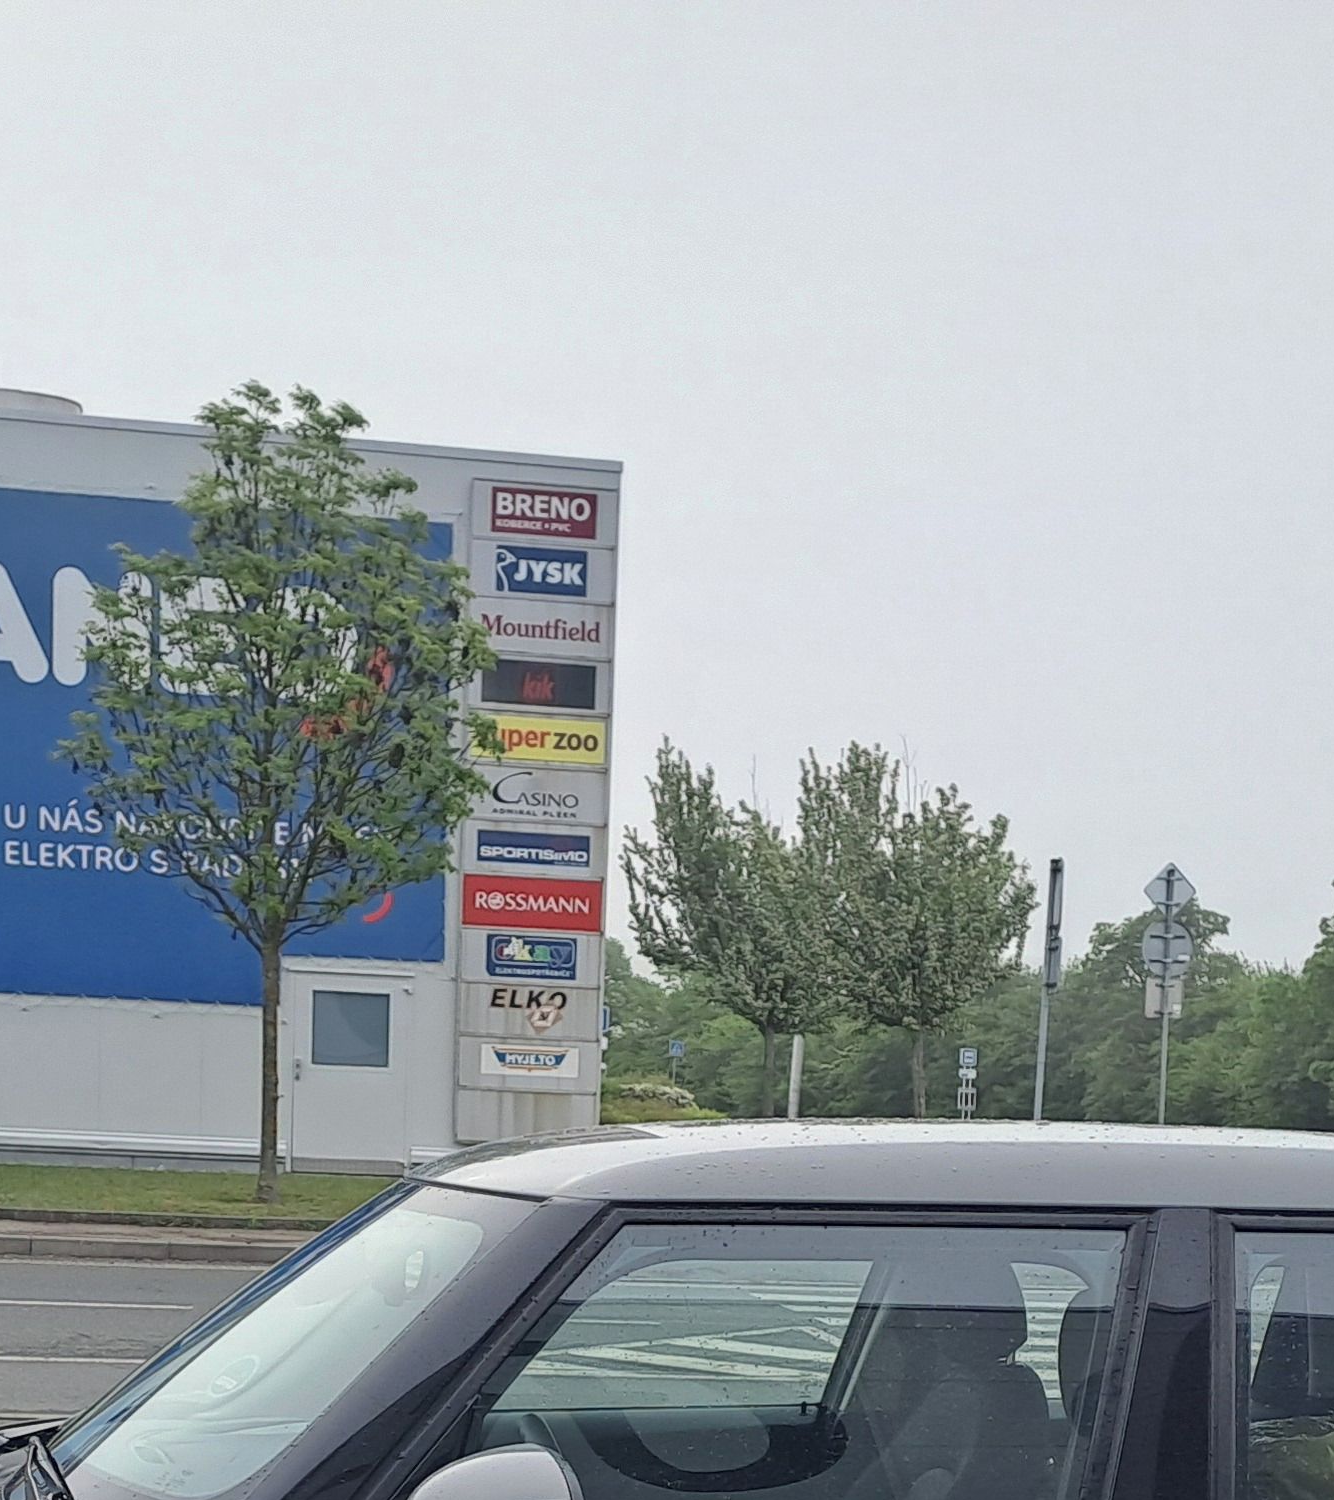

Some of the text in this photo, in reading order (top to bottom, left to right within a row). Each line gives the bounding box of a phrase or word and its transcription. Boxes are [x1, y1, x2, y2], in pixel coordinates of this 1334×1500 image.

[495, 491, 591, 522] BRENO
[513, 559, 584, 586] JYSK
[481, 613, 601, 643] Mountfield
[492, 771, 579, 808] CASINO
[3, 804, 25, 829] U
[39, 800, 103, 834] NÁS
[3, 841, 139, 873] ELEKTRO
[150, 848, 169, 874] S
[474, 890, 589, 914] ROSSMANN
[490, 988, 567, 1009] ELKO
